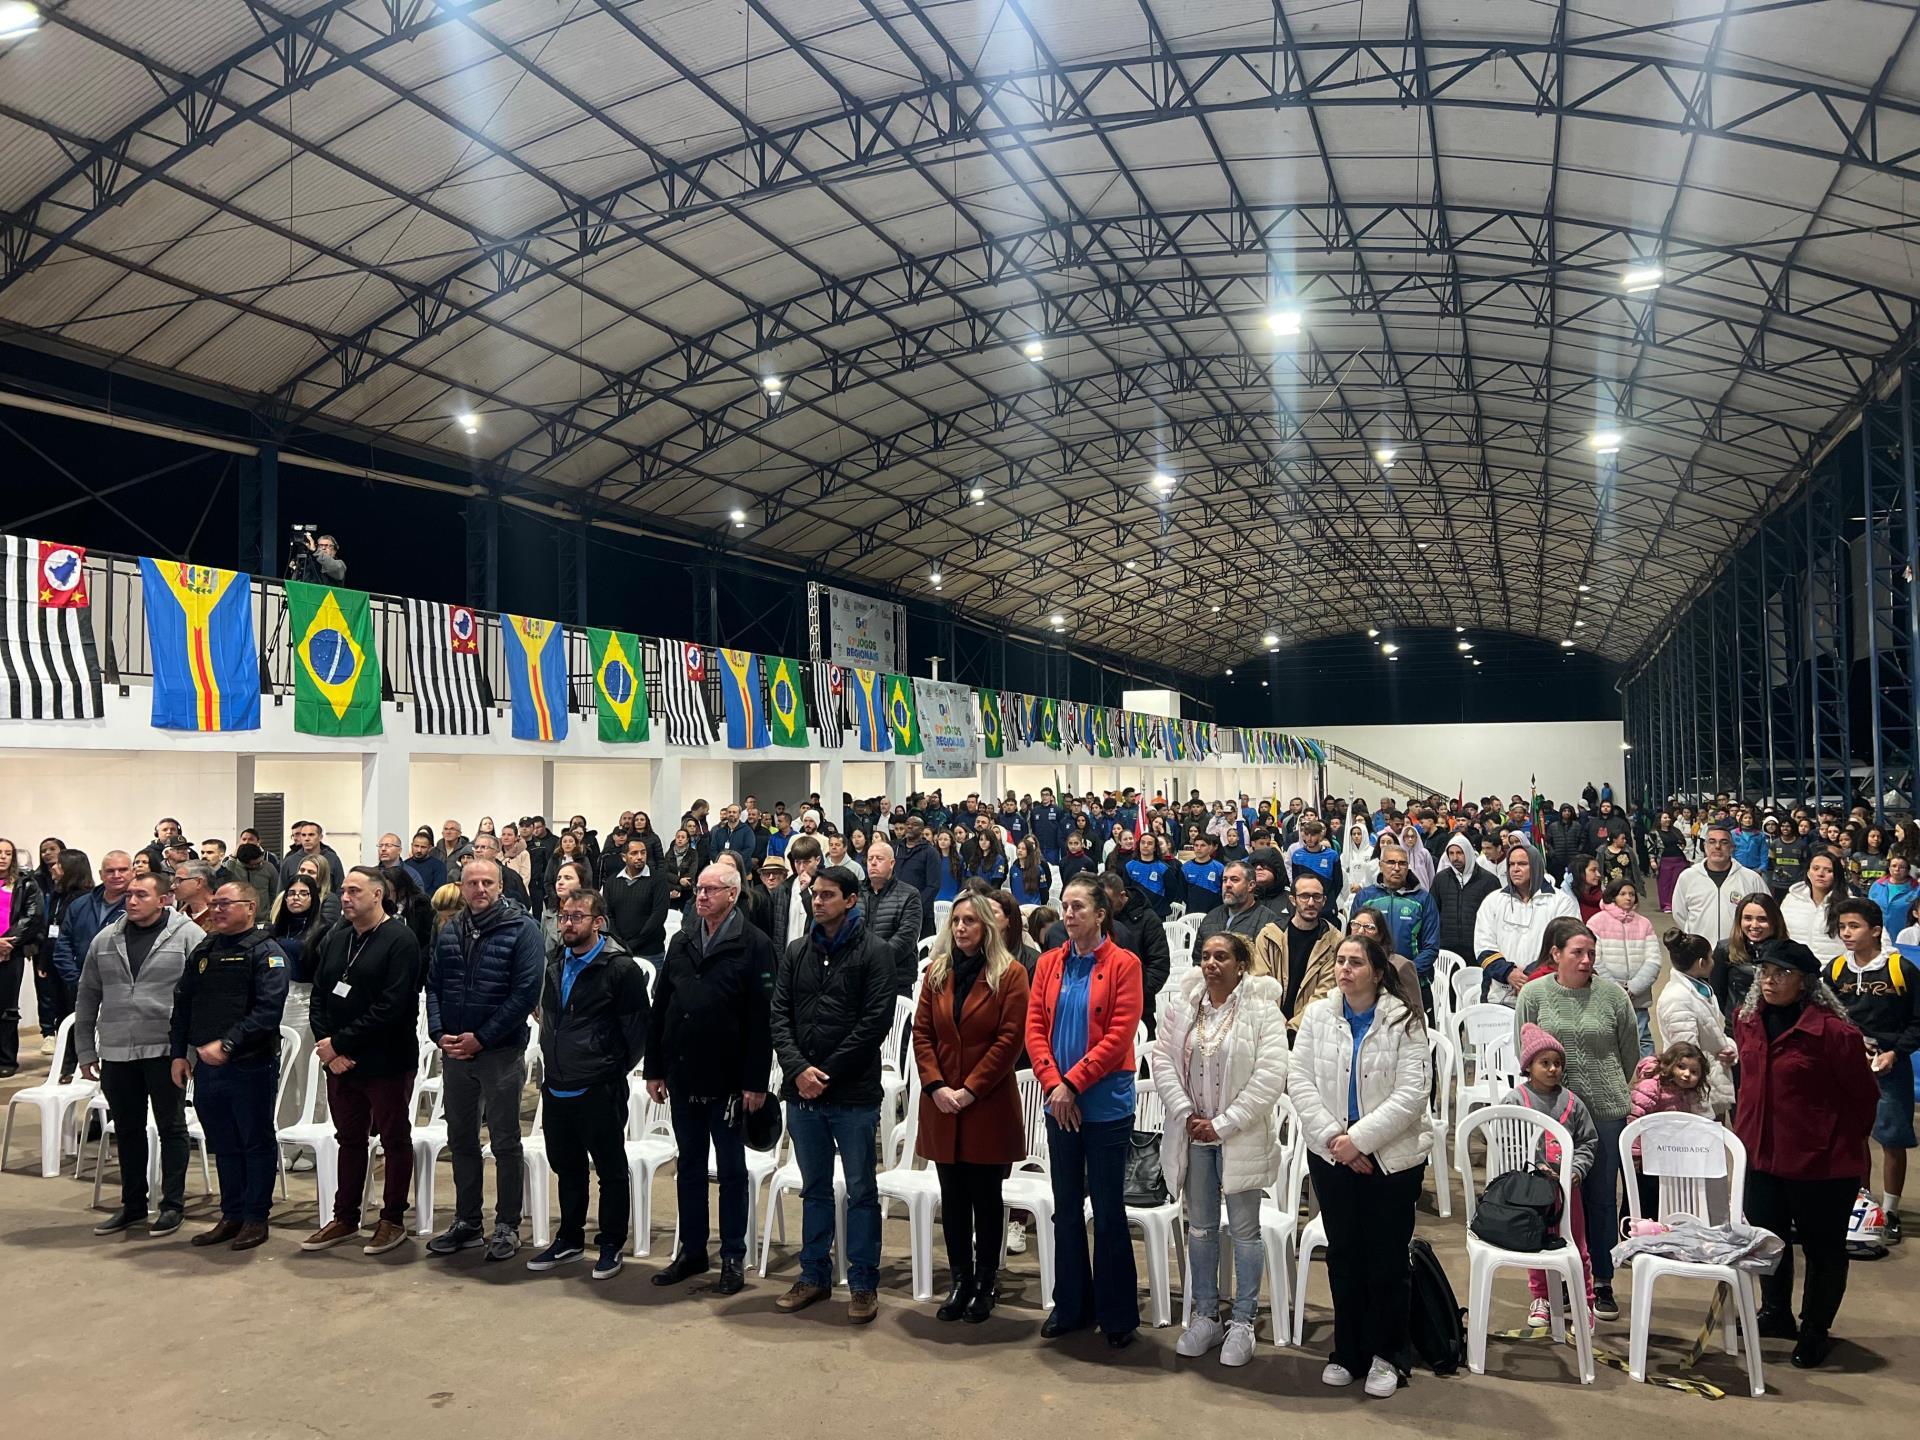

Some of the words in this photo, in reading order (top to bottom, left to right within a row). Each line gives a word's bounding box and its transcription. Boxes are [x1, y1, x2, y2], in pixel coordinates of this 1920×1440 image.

[857, 638, 877, 651] JOGOS
[846, 646, 880, 661] REGIONAIS
[944, 724, 962, 737] JOGOS
[935, 735, 966, 748] REGIONAIS
[1656, 1144, 1710, 1153] AUTORIDADES
